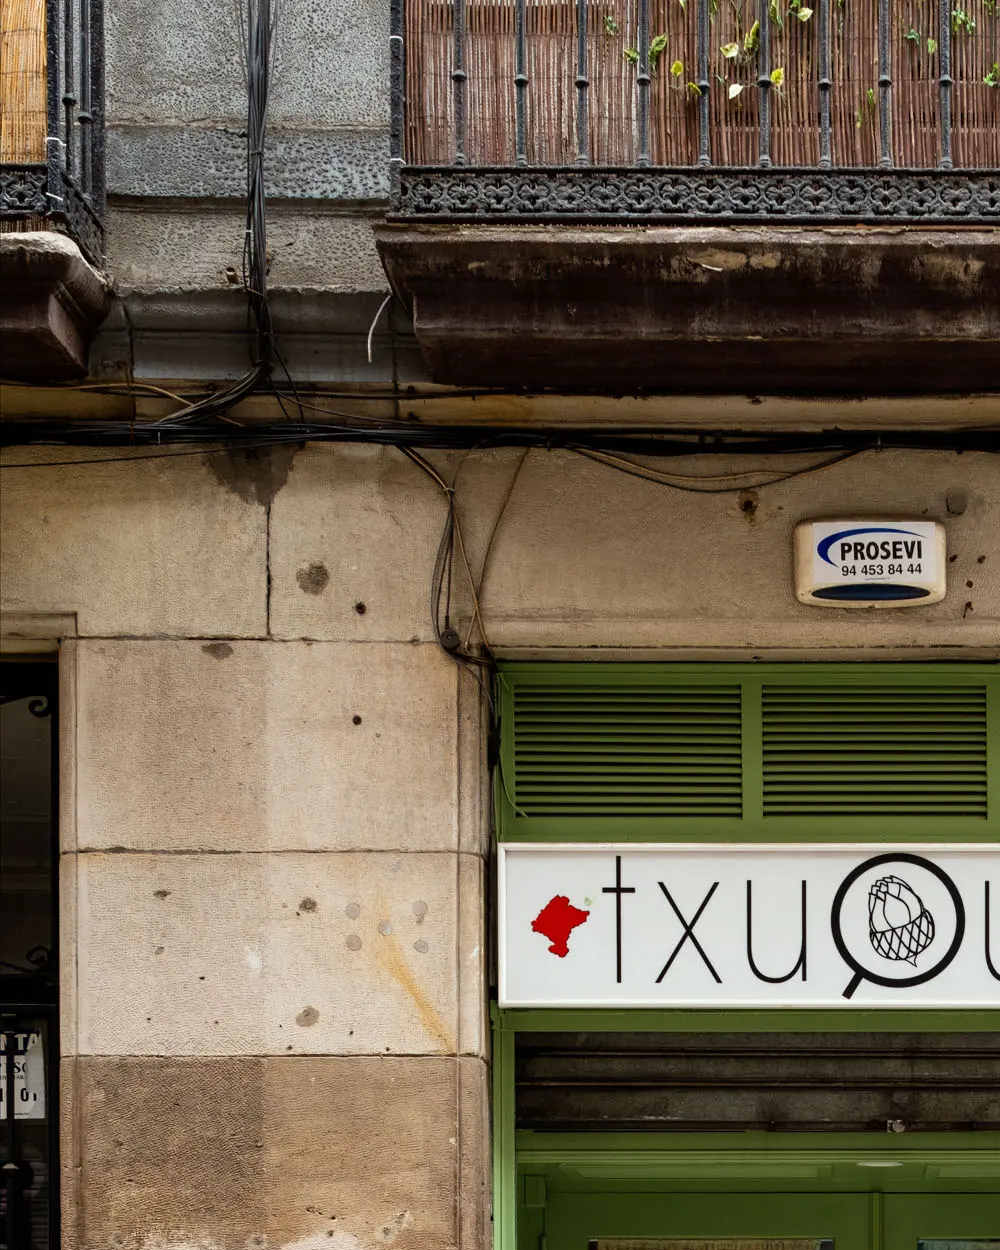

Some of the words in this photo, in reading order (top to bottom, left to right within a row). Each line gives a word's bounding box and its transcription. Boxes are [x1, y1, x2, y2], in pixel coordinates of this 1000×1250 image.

[840, 540, 922, 561] PROSEVI
[841, 565, 857, 576] 94
[861, 564, 884, 575] 453
[888, 564, 903, 574] 84
[907, 563, 922, 574] 44
